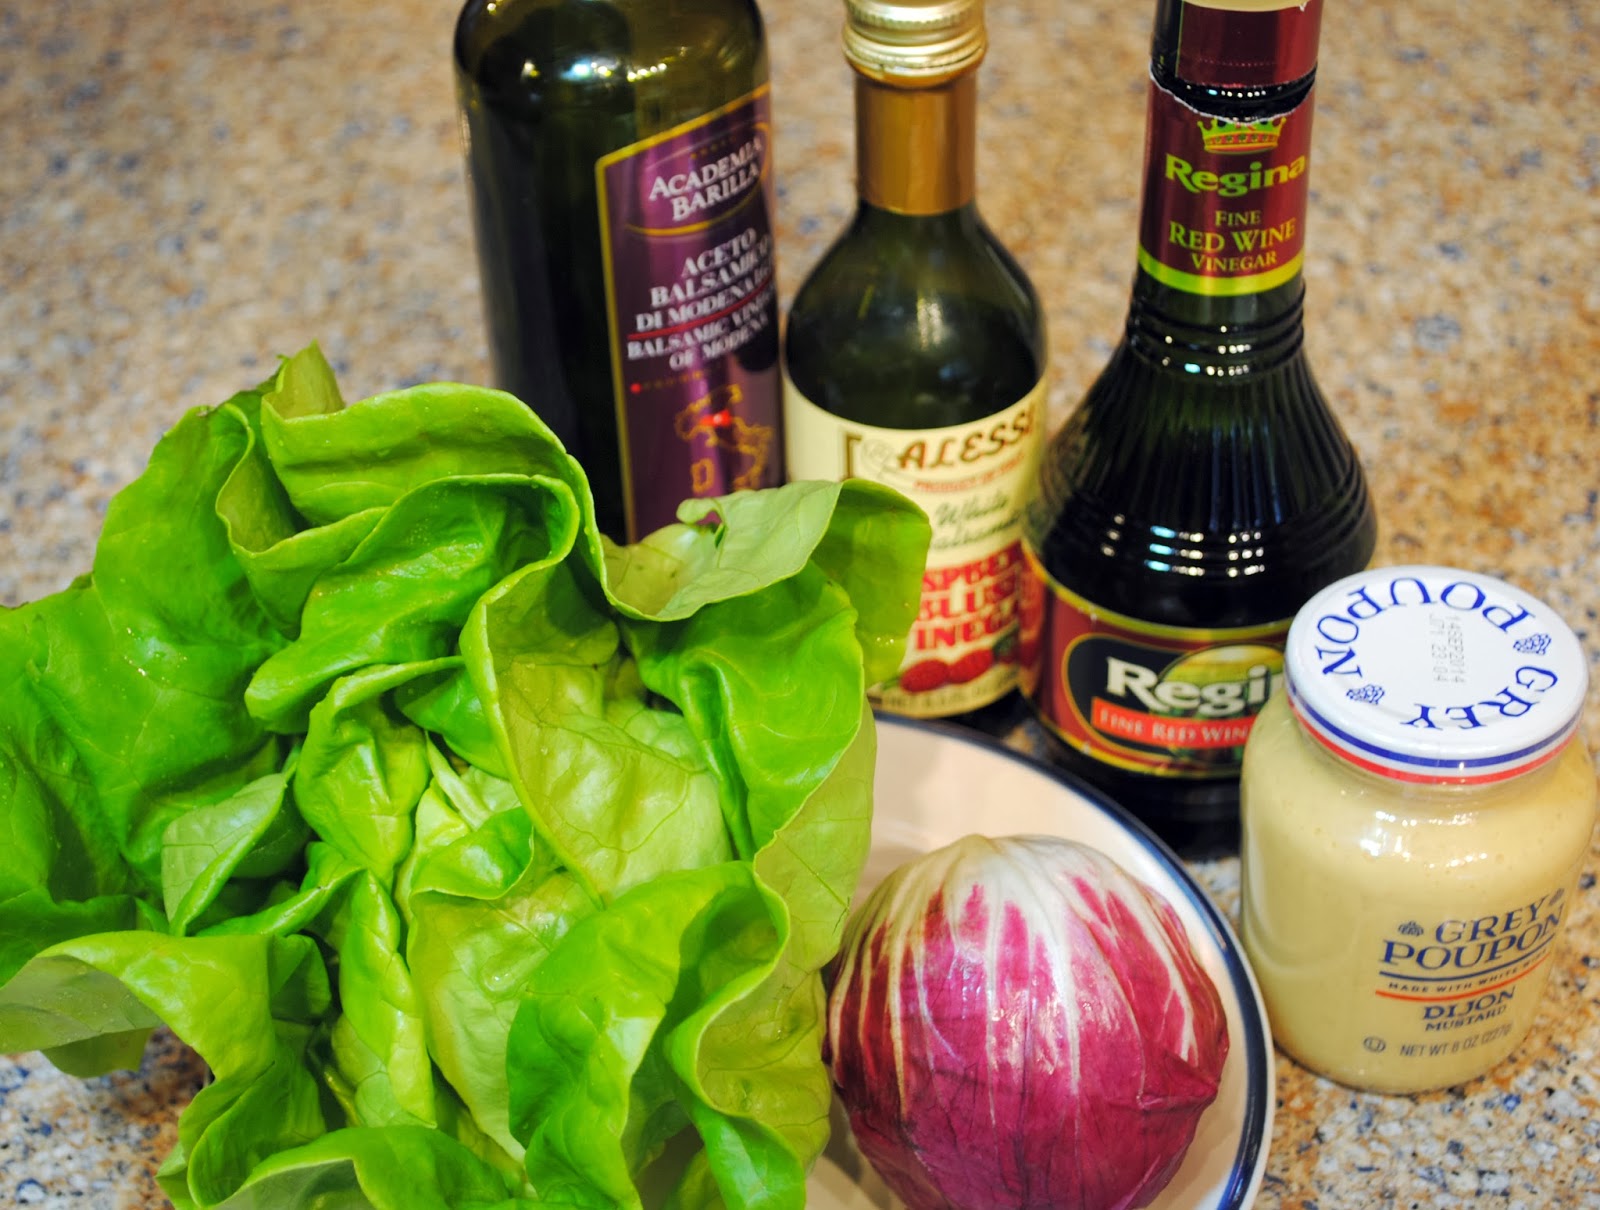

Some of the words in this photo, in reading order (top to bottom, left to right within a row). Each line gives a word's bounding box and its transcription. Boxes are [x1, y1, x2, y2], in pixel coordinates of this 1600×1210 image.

[649, 137, 763, 201] ACADEMIA
[1165, 153, 1307, 197] Regina
[670, 162, 760, 221] BARILLA
[1169, 220, 1225, 253] RED
[1232, 217, 1297, 253] WINE
[1215, 210, 1262, 227] FINE
[681, 227, 757, 278] ACETO
[1191, 250, 1278, 272] VINEGAR
[627, 317, 730, 360] BALSAMIC
[635, 310, 663, 332] DI
[669, 348, 695, 371] OF
[1314, 576, 1536, 678] POUPON
[1400, 665, 1558, 730] GREY
[1100, 708, 1143, 734] FINE
[1152, 721, 1196, 742] RED
[1203, 725, 1250, 742] WIN
[1380, 903, 1565, 970] POUPON
[1435, 894, 1549, 944] GREY
[1389, 981, 1430, 993] MADE
[1437, 982, 1473, 993] WITH
[1423, 986, 1516, 1020] DIJON
[1425, 1004, 1507, 1032] MUSTARD
[1400, 1044, 1426, 1057] NET
[1429, 1042, 1448, 1056] WT
[1463, 1034, 1480, 1050] OZ
